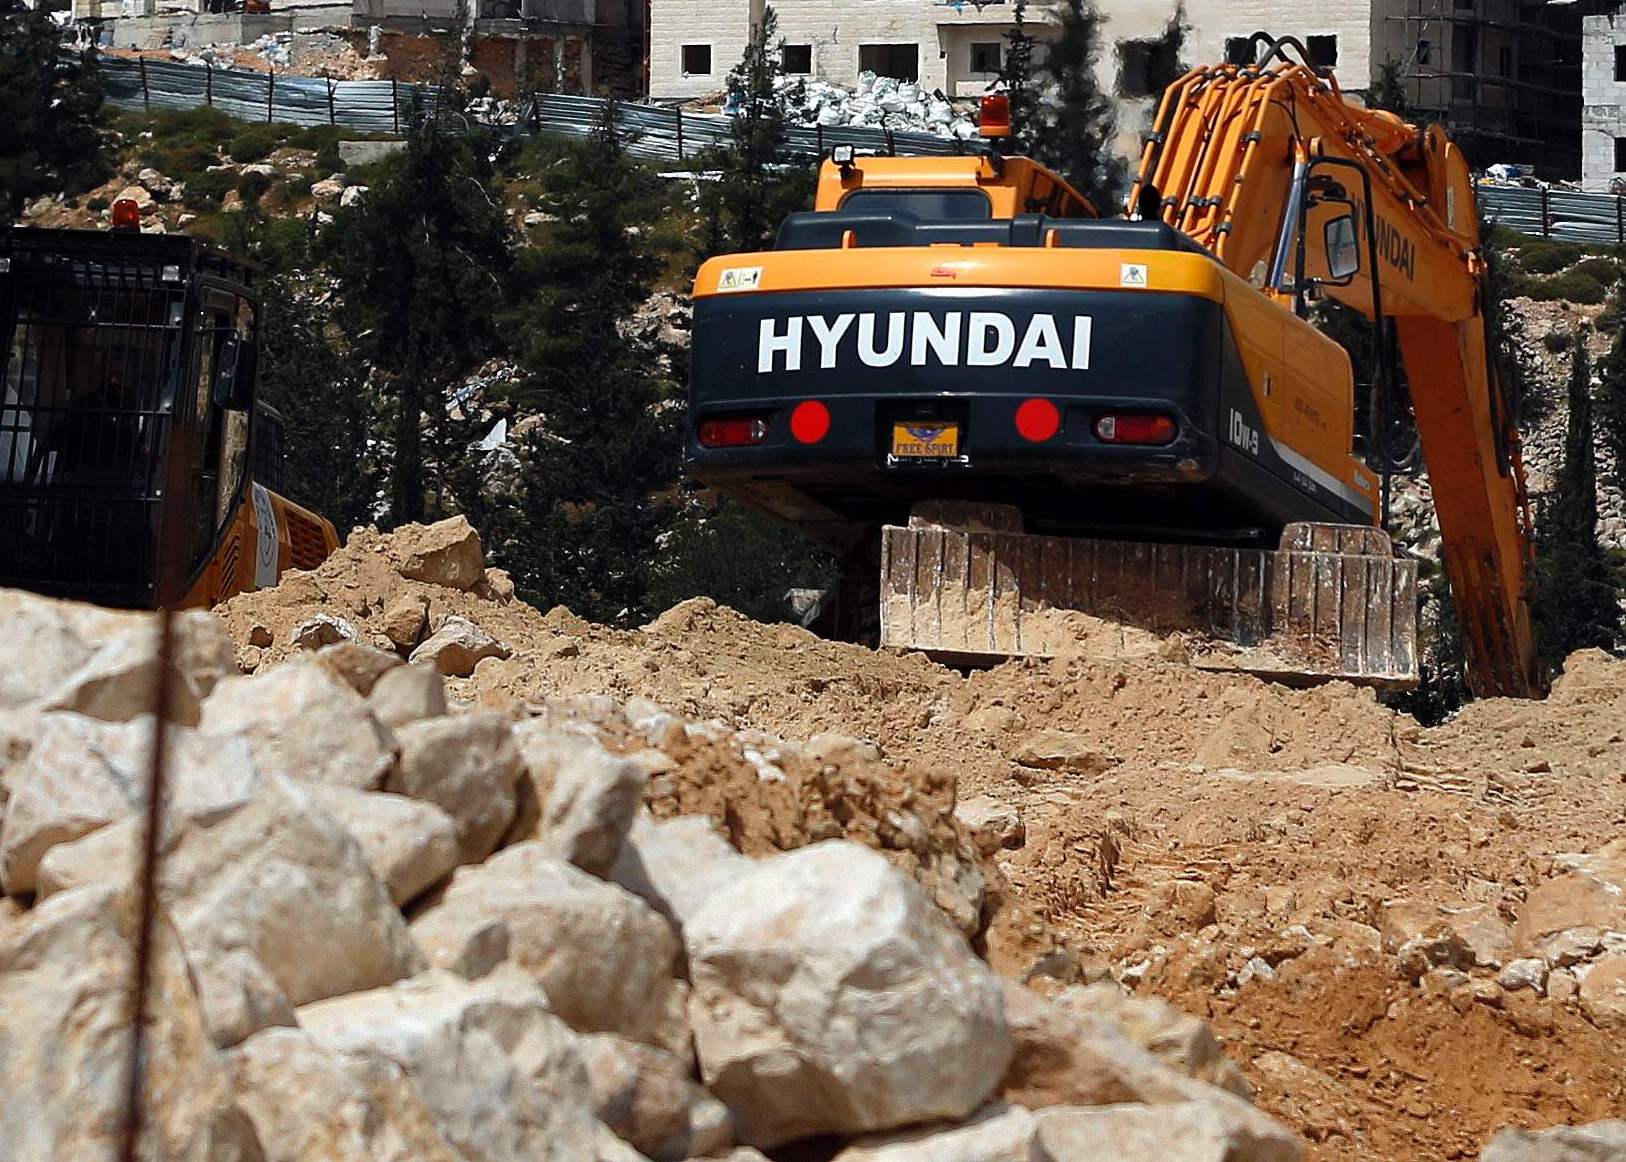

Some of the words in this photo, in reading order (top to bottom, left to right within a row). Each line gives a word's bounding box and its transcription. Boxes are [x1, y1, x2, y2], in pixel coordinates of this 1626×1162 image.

[758, 311, 1092, 373] HYUNDAI
[896, 443, 923, 454] FREE
[925, 443, 954, 454] SPIRT
